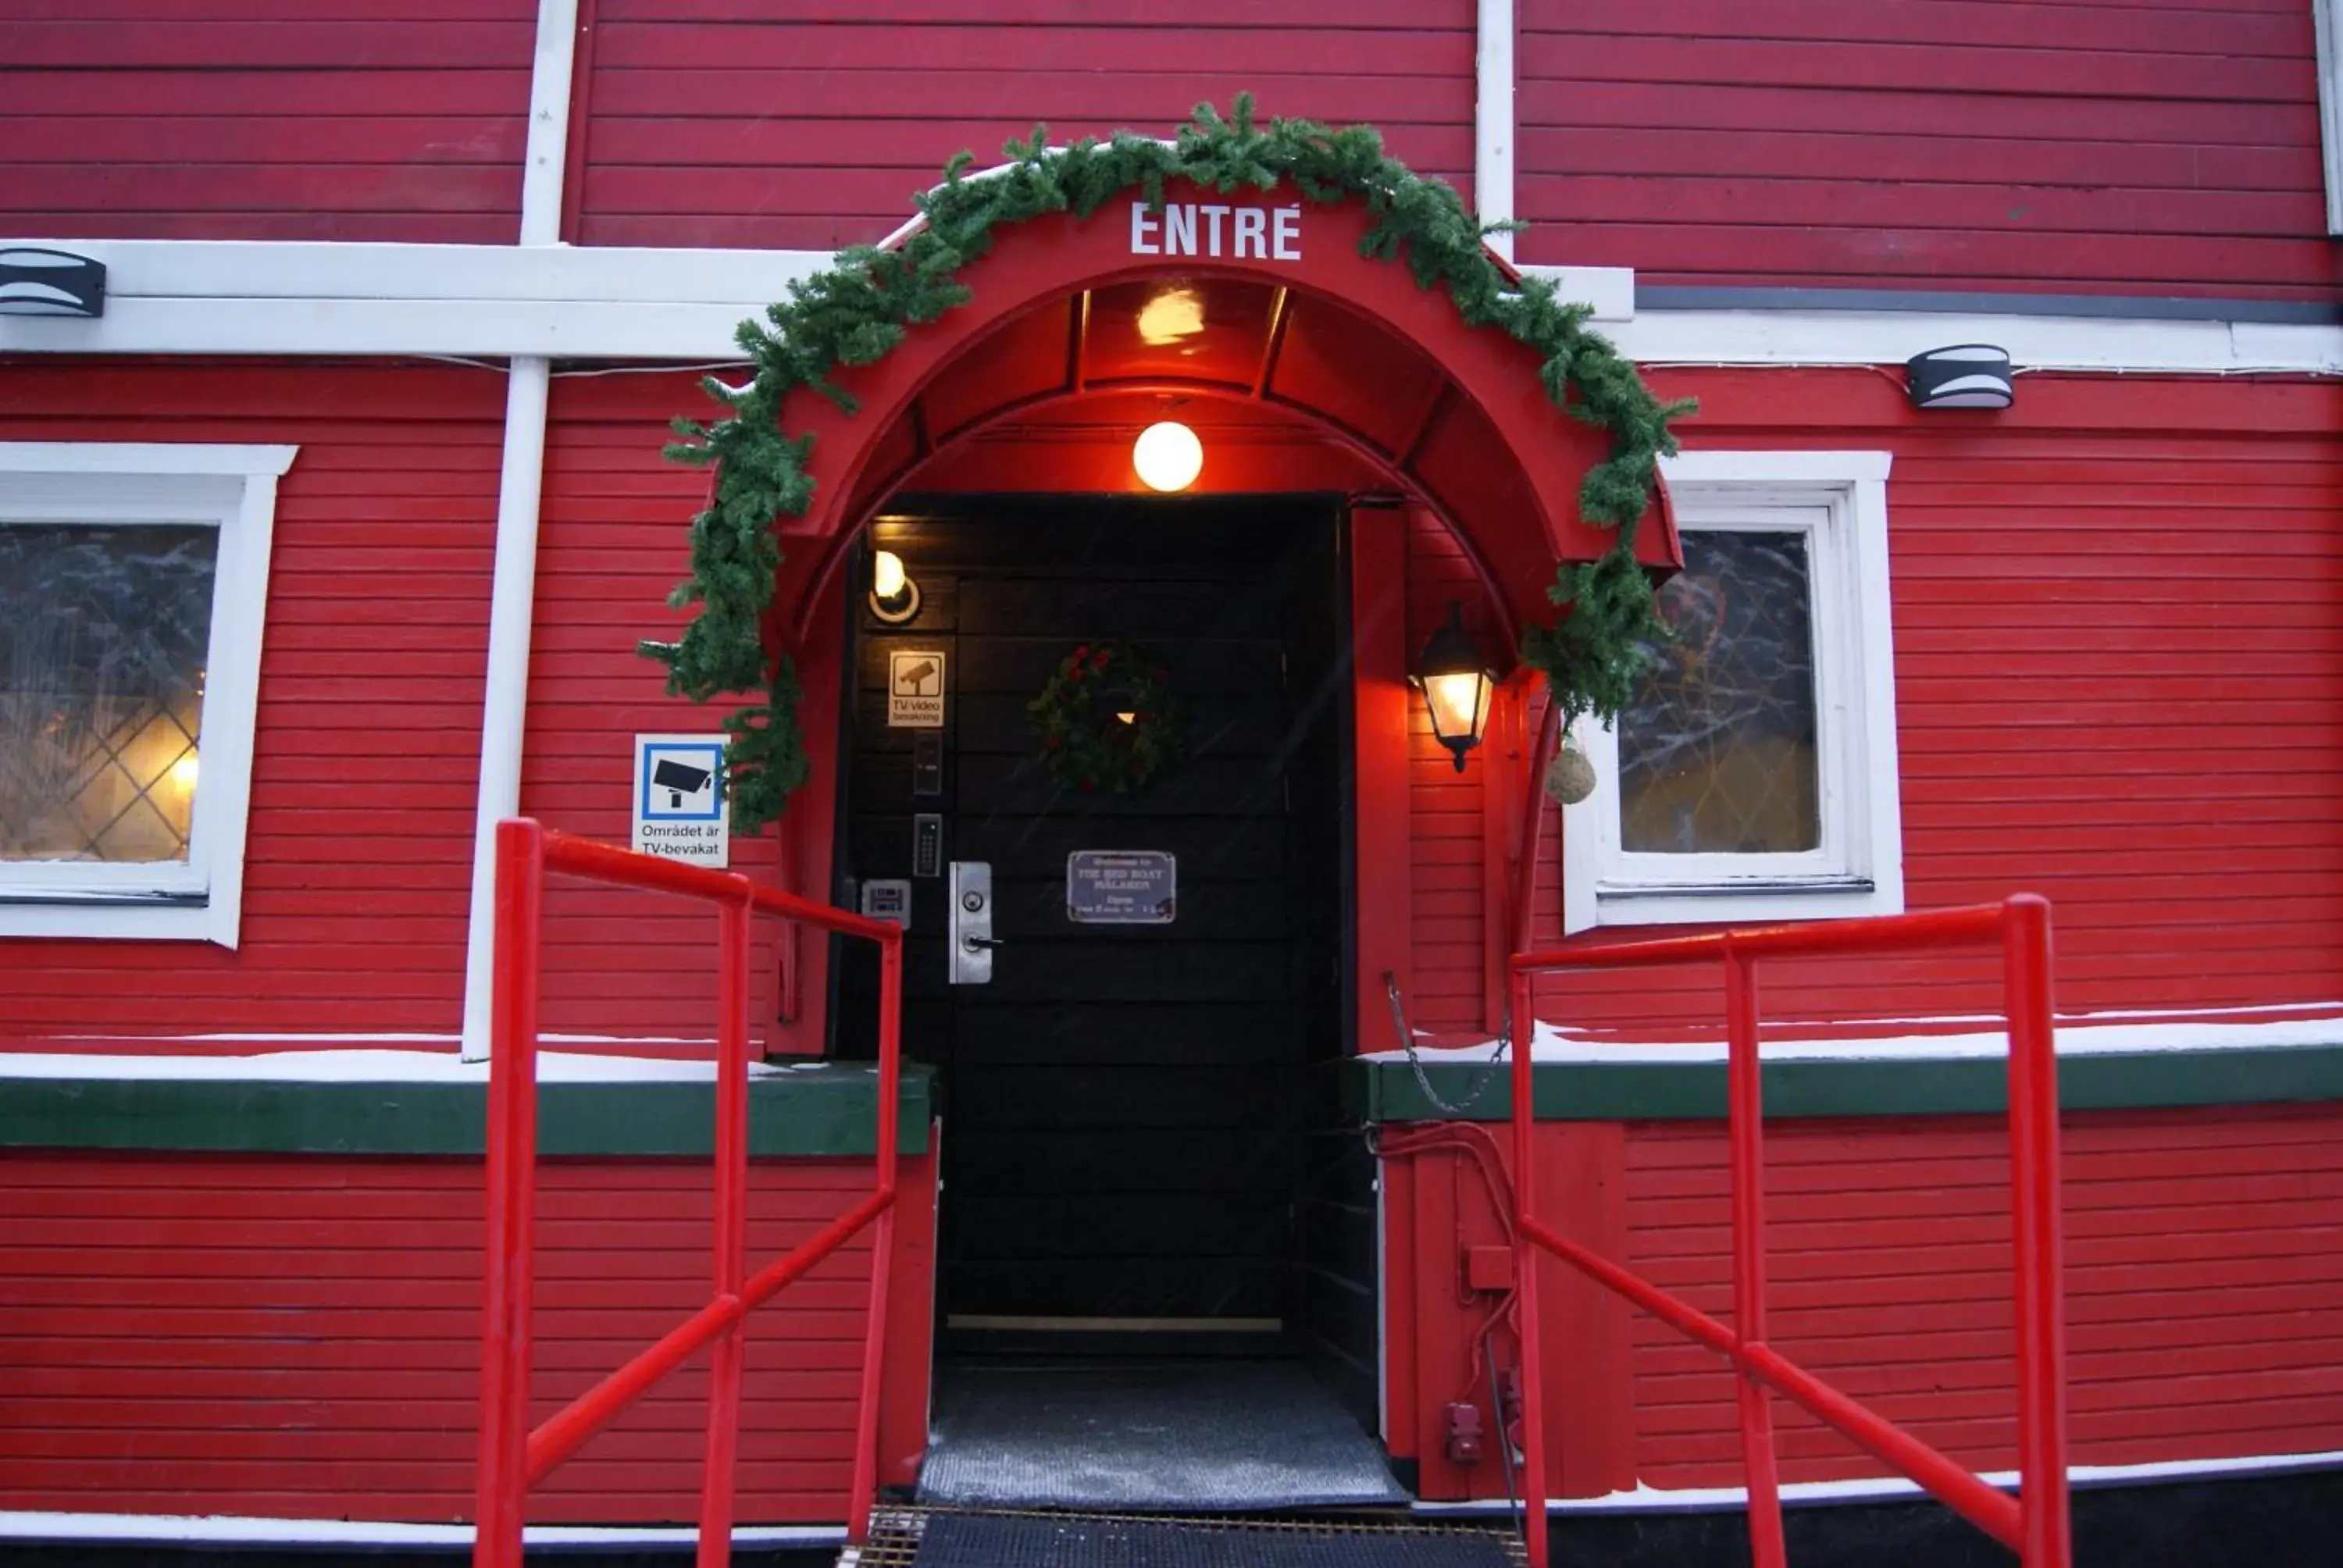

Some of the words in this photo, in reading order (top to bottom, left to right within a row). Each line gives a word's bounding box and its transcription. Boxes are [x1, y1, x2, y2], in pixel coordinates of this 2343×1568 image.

[1131, 201, 1301, 261] ENTRÉ
[642, 824, 702, 837] Området
[706, 825, 719, 837] är
[642, 843, 719, 855] TV-bevakat
[1131, 869, 1164, 879] BOAT
